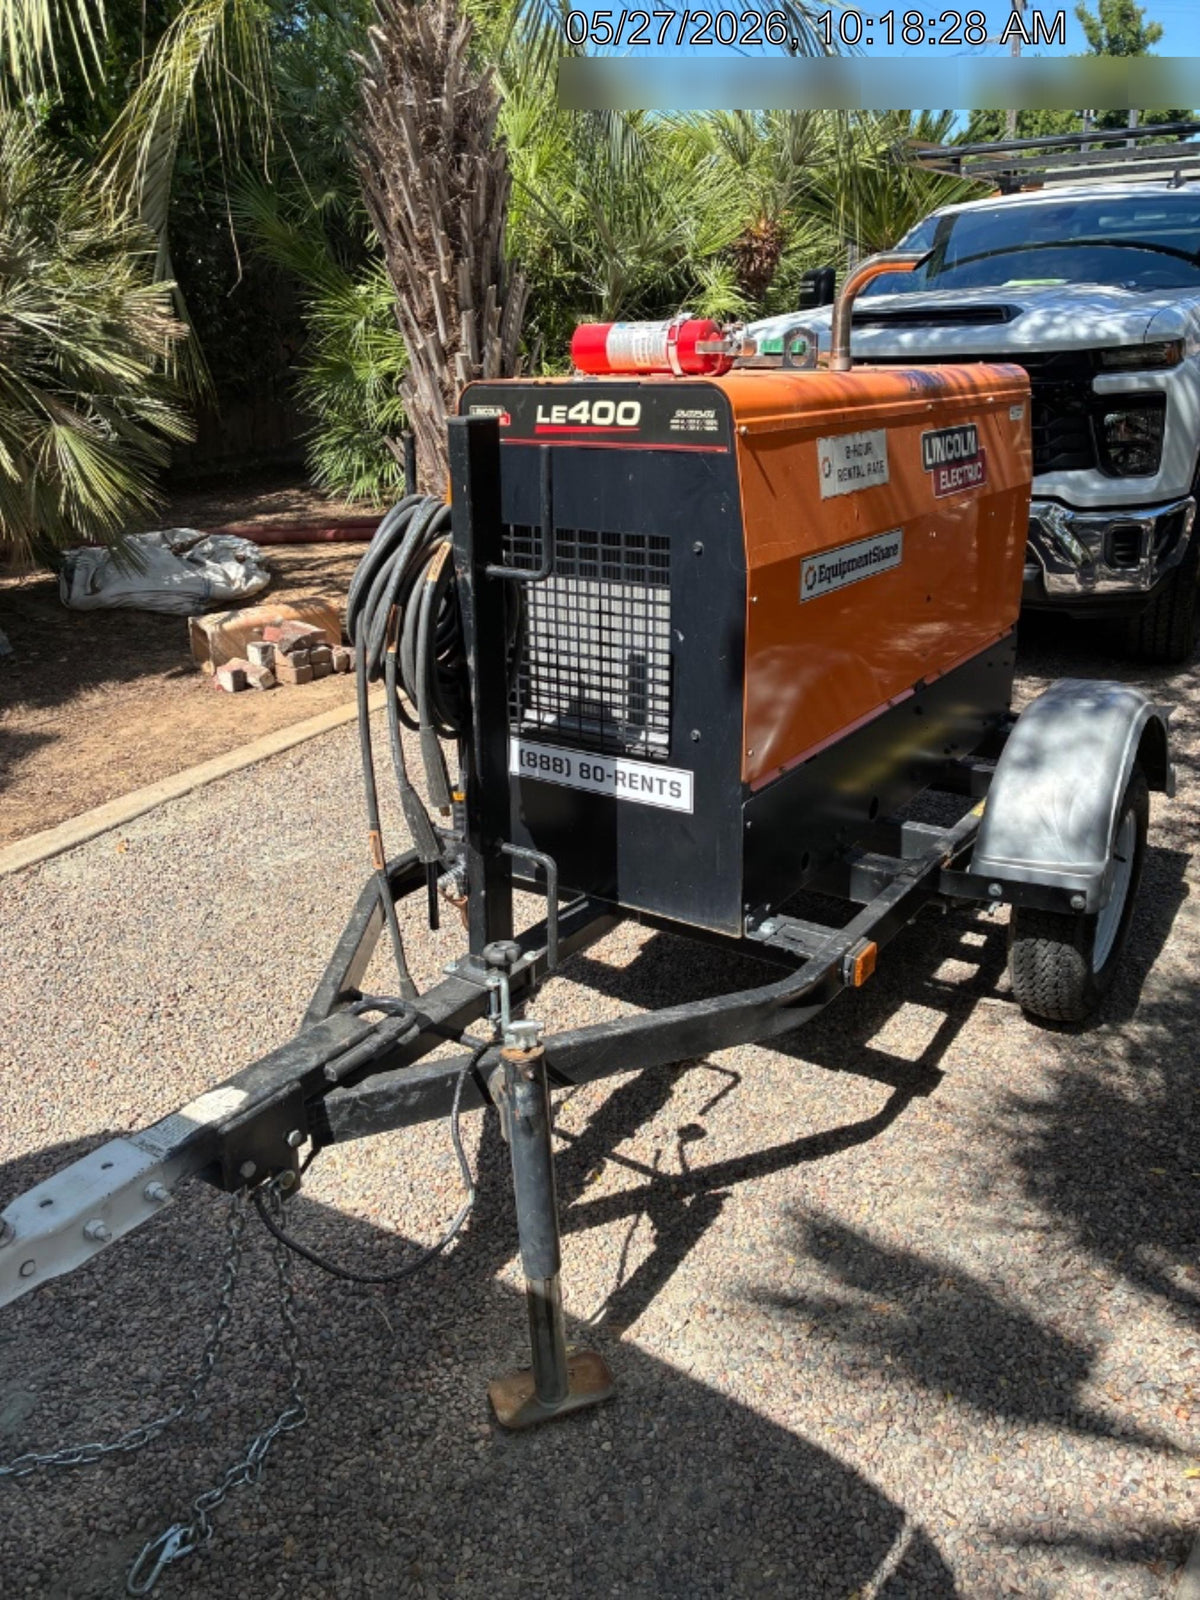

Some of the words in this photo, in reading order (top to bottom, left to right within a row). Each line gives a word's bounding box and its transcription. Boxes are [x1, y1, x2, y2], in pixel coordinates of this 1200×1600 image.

[536, 400, 641, 426] LE400
[924, 430, 977, 465] LINCOLN
[940, 462, 983, 490] ELECTRIC
[818, 543, 899, 585] EquipmentShare
[518, 748, 572, 778] (888)
[578, 761, 682, 800] 80-RENTS
